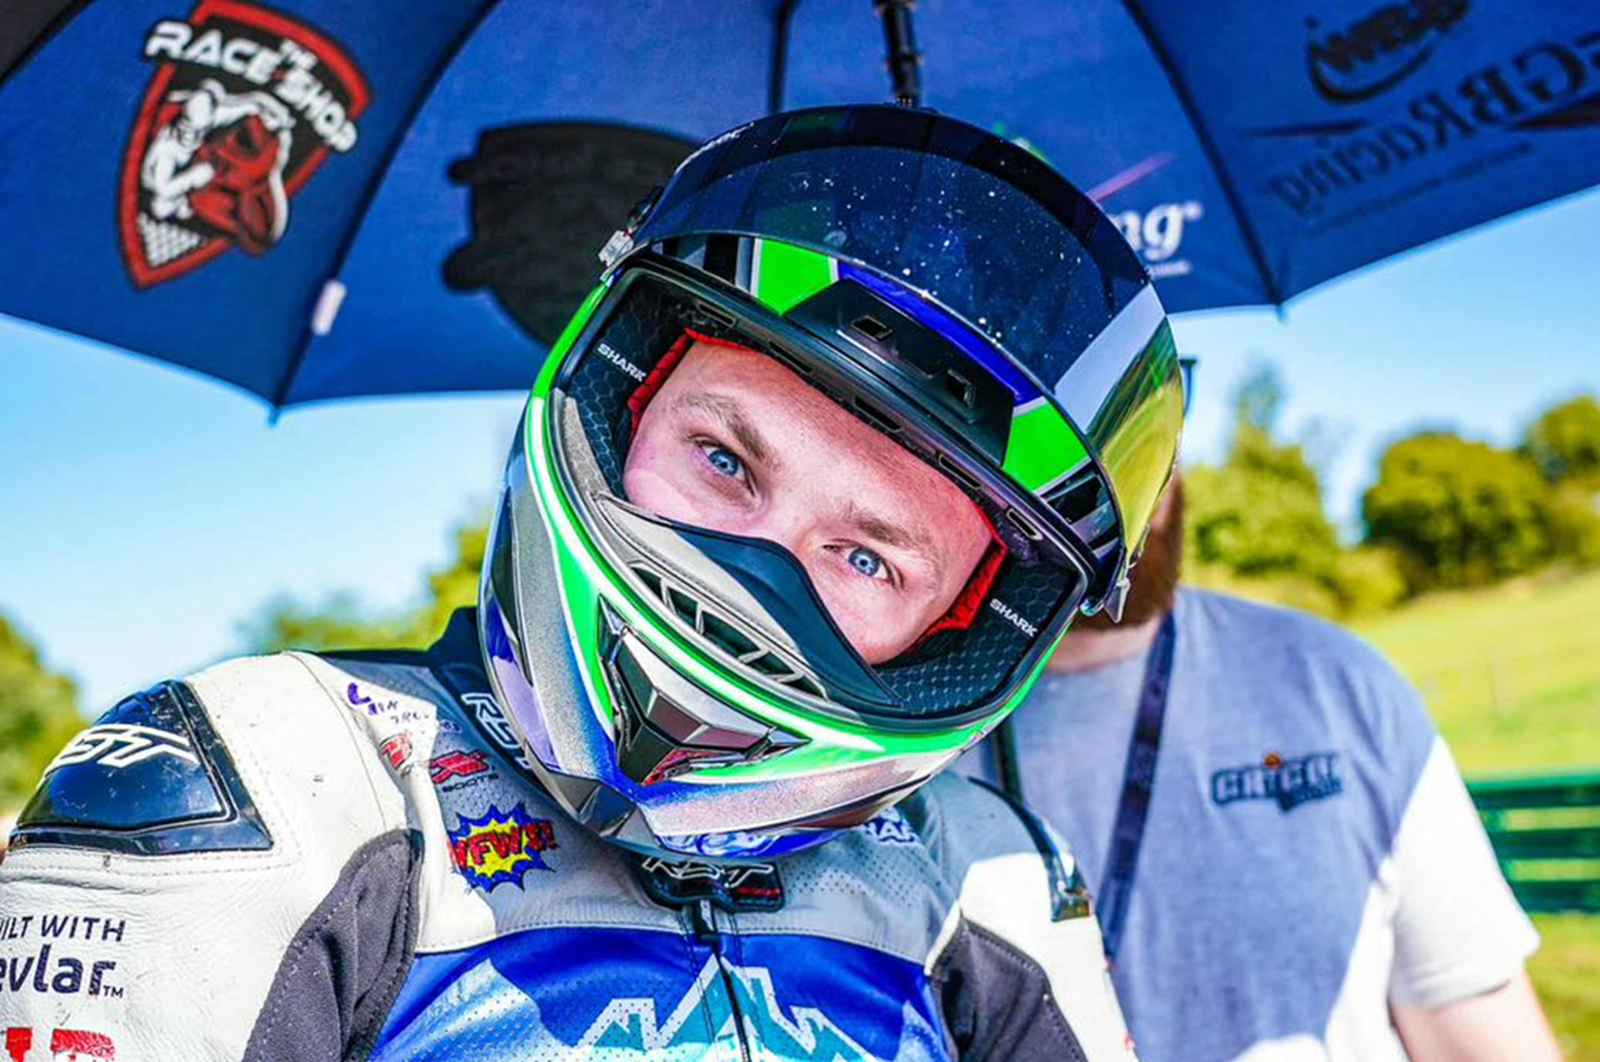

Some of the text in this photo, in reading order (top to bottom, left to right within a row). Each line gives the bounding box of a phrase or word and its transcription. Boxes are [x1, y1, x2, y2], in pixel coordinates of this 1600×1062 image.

[145, 20, 281, 84] RACE
[597, 342, 647, 382] SHARK
[989, 598, 1038, 637] SHARK
[0, 914, 126, 942] ILT WITH
